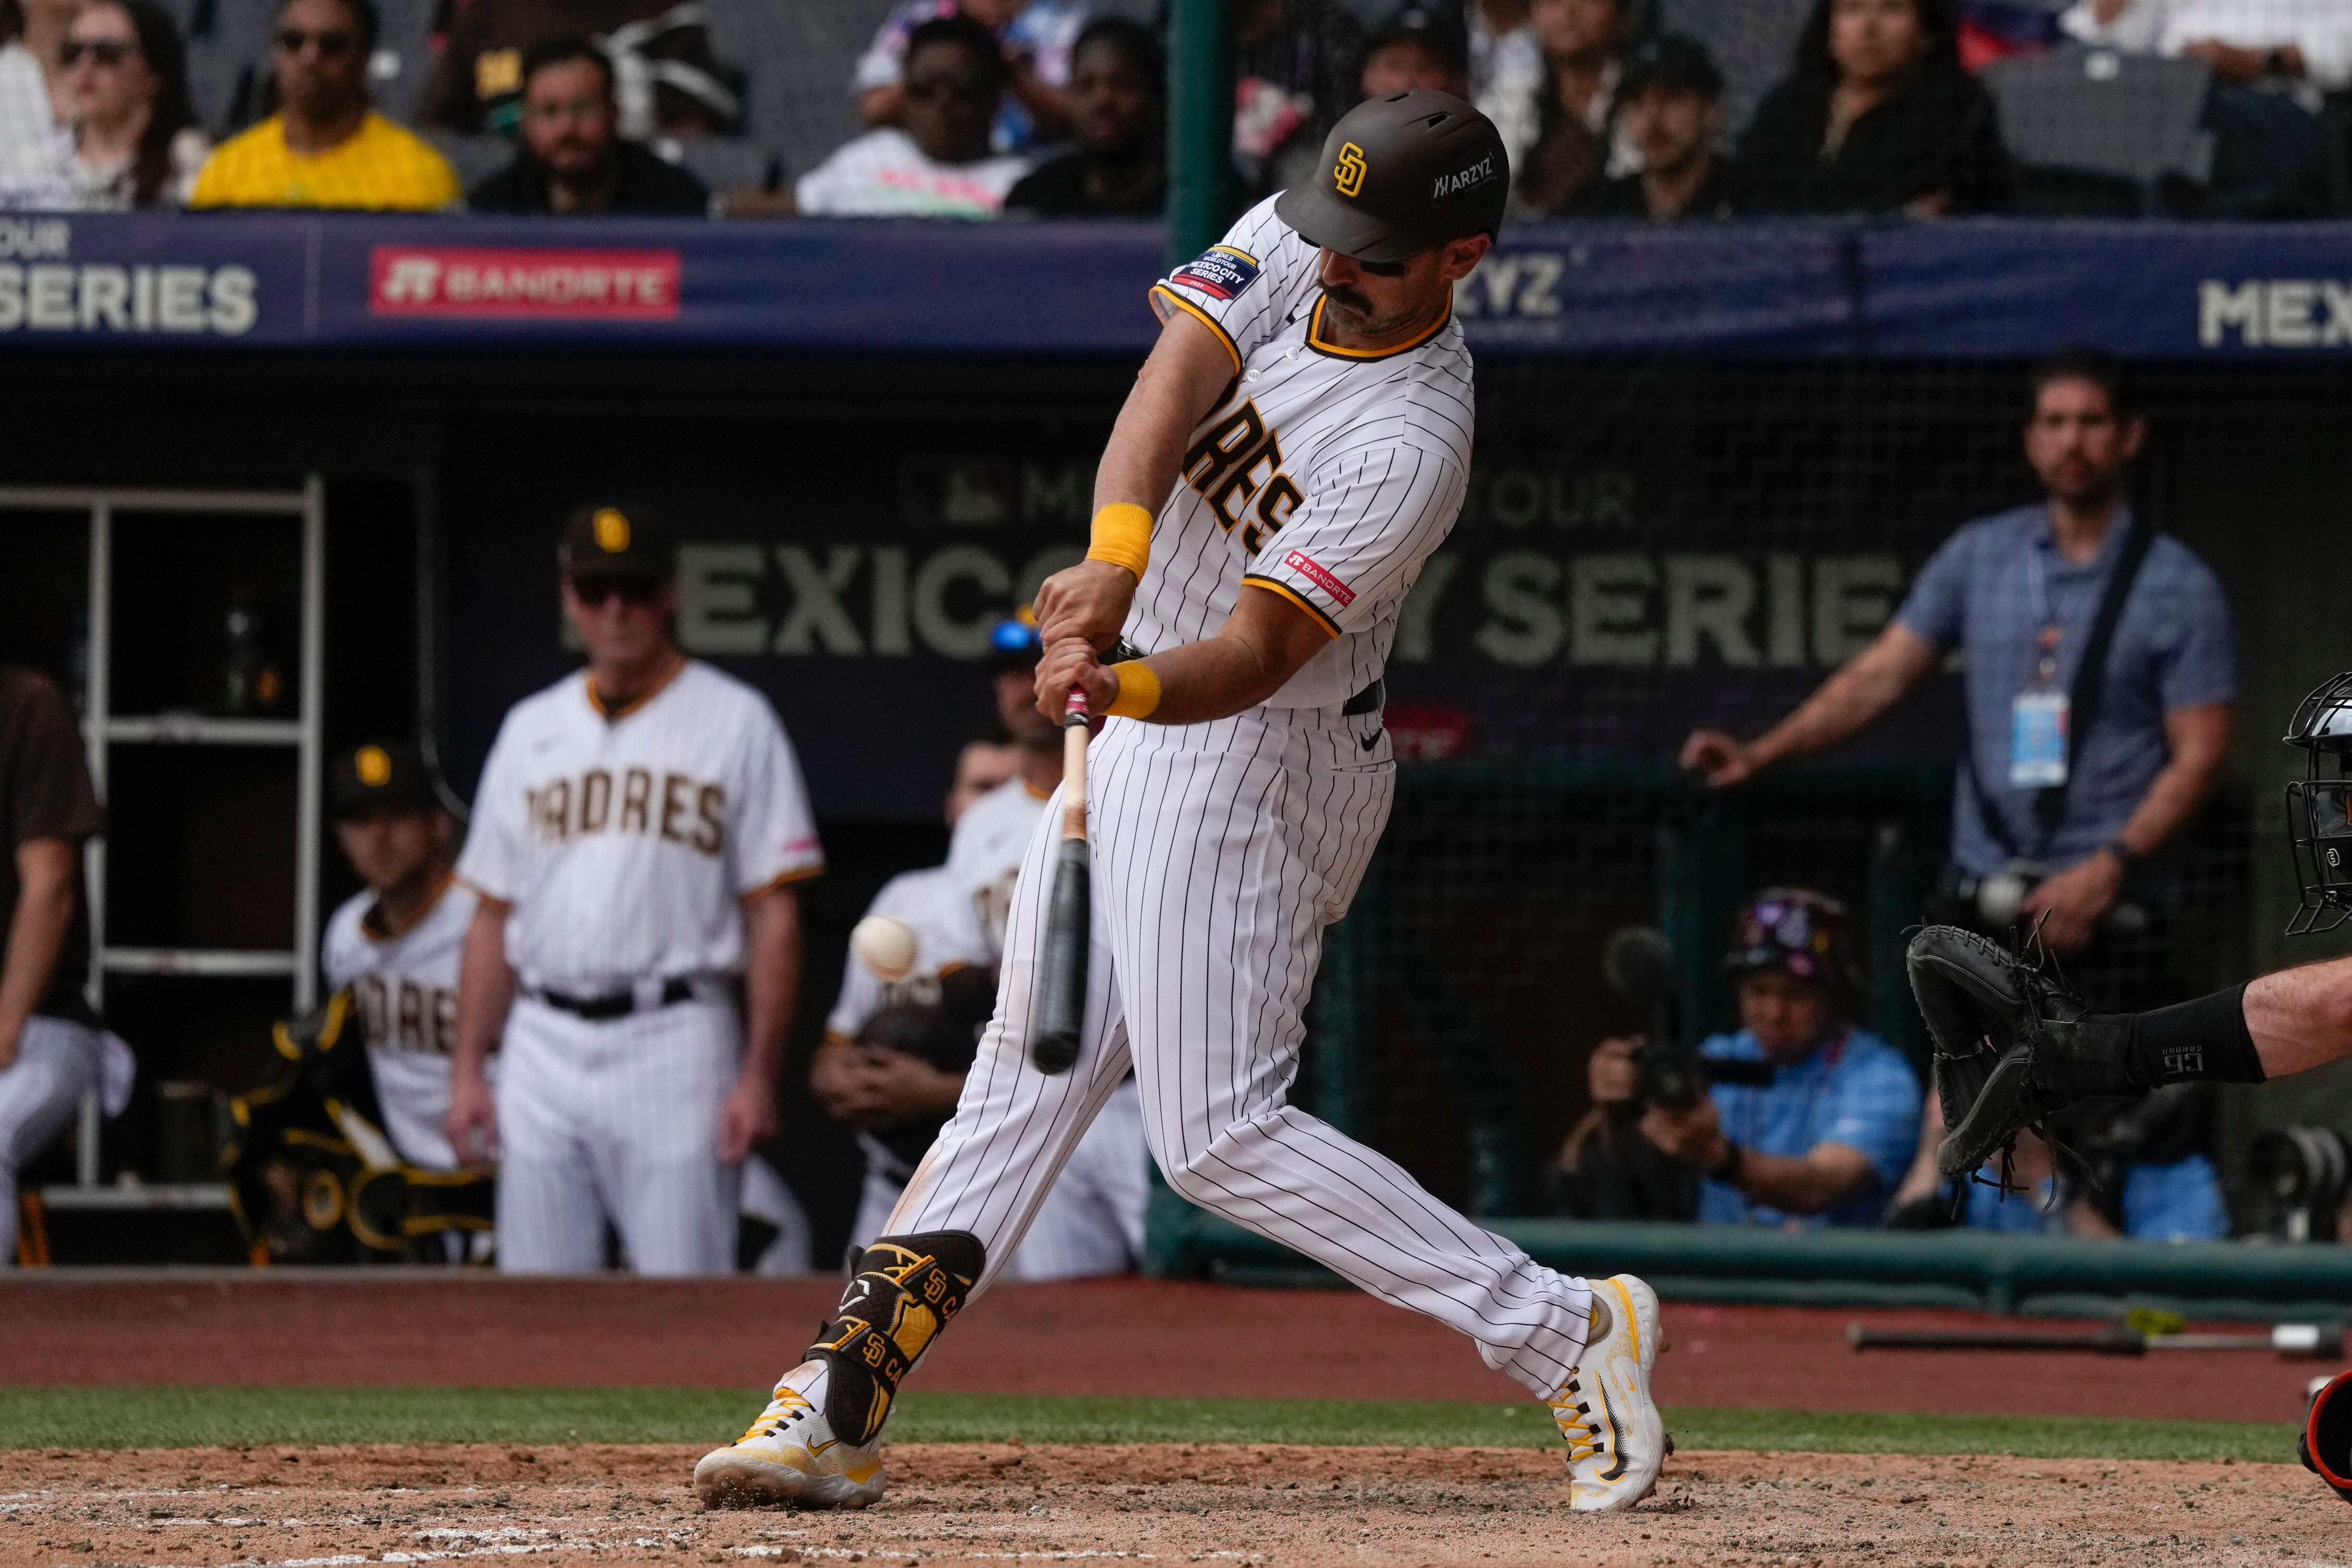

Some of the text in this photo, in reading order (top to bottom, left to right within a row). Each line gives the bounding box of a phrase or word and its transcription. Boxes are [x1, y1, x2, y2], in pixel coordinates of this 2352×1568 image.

[1187, 261, 1245, 284] MEXICO CITY
[1190, 268, 1224, 284] SERIES
[1203, 256, 1237, 271] WORLD TOUR
[1221, 252, 1234, 261] MLB
[444, 265, 666, 304] BANORTE
[2198, 279, 2352, 348] MEX
[1181, 386, 1305, 557] RES
[673, 542, 1088, 659] EXIC
[1302, 562, 1352, 604] BANORTE
[1473, 550, 1907, 668] SERIE
[836, 1323, 866, 1347] EVOSHIELD
